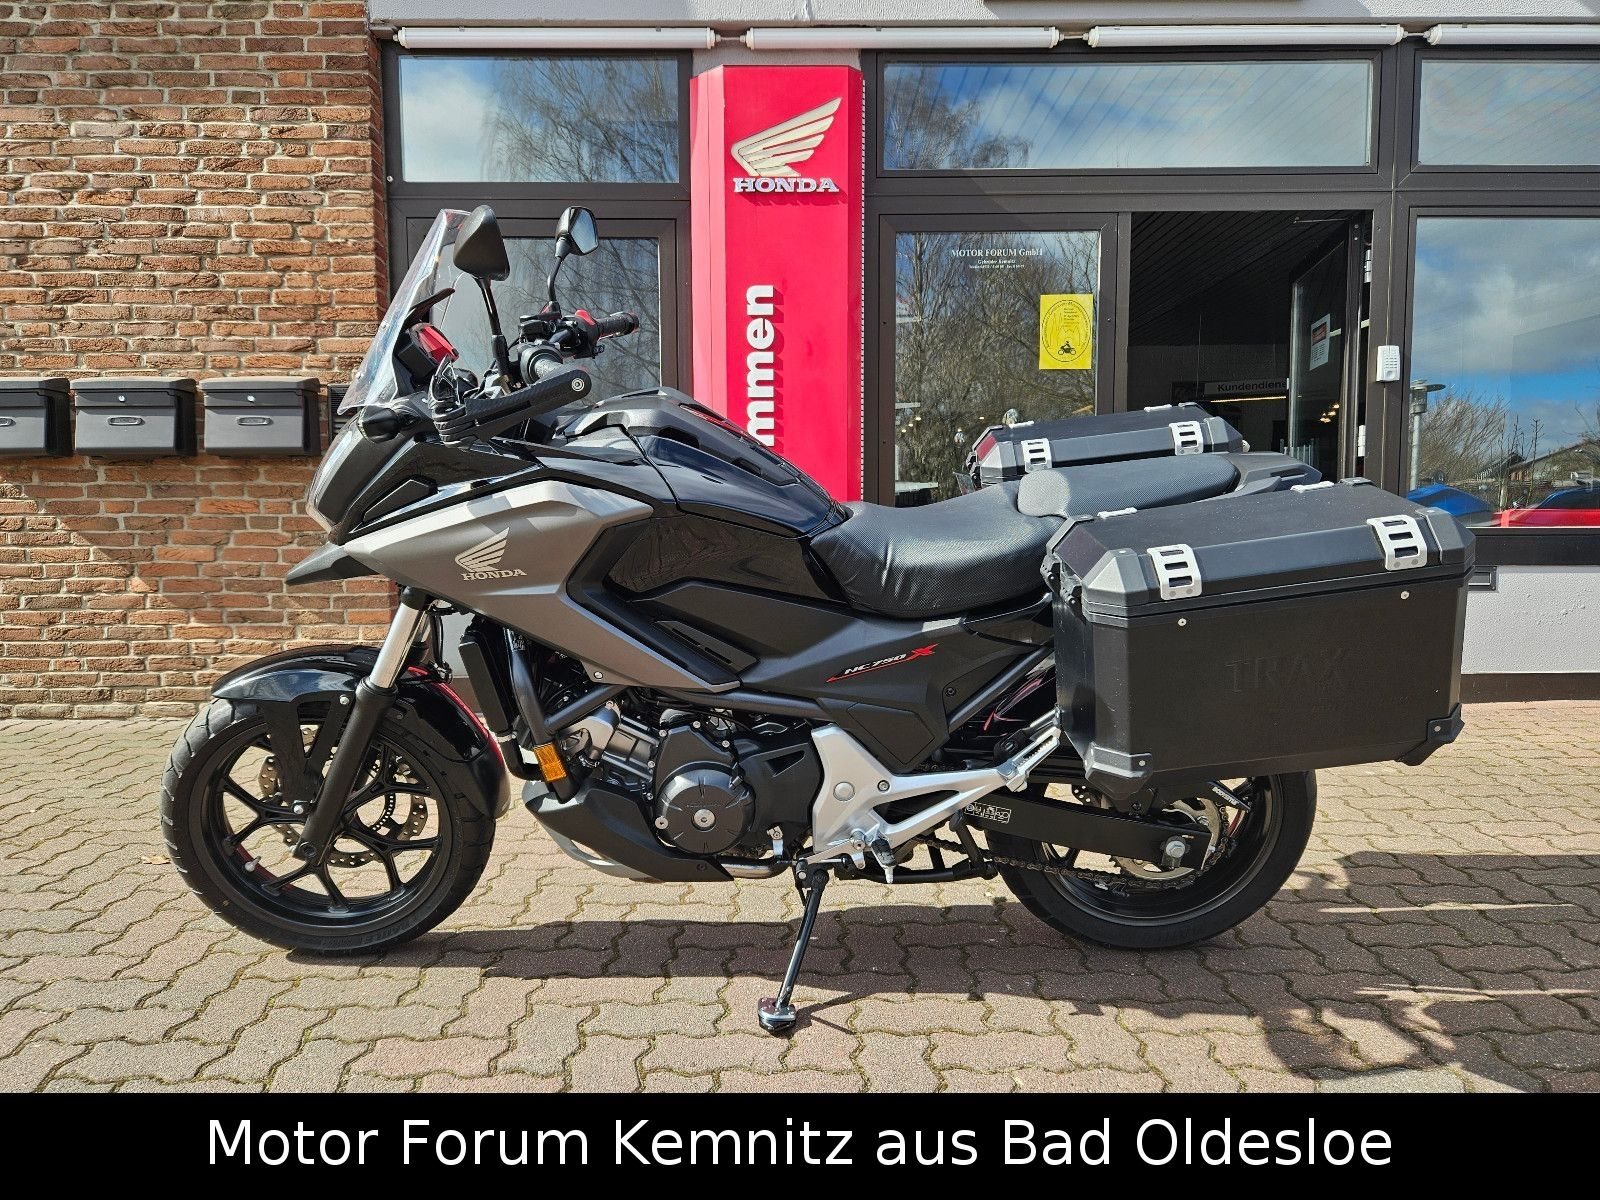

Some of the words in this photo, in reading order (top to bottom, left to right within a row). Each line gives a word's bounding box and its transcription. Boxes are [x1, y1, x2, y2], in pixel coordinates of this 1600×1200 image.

[733, 177, 840, 193] HONDA
[951, 248, 984, 257] MOTOR
[985, 248, 1017, 257] FORUM
[1018, 247, 1043, 256] GmbH
[461, 568, 528, 581] HONDA
[1224, 646, 1350, 693] TRAX
